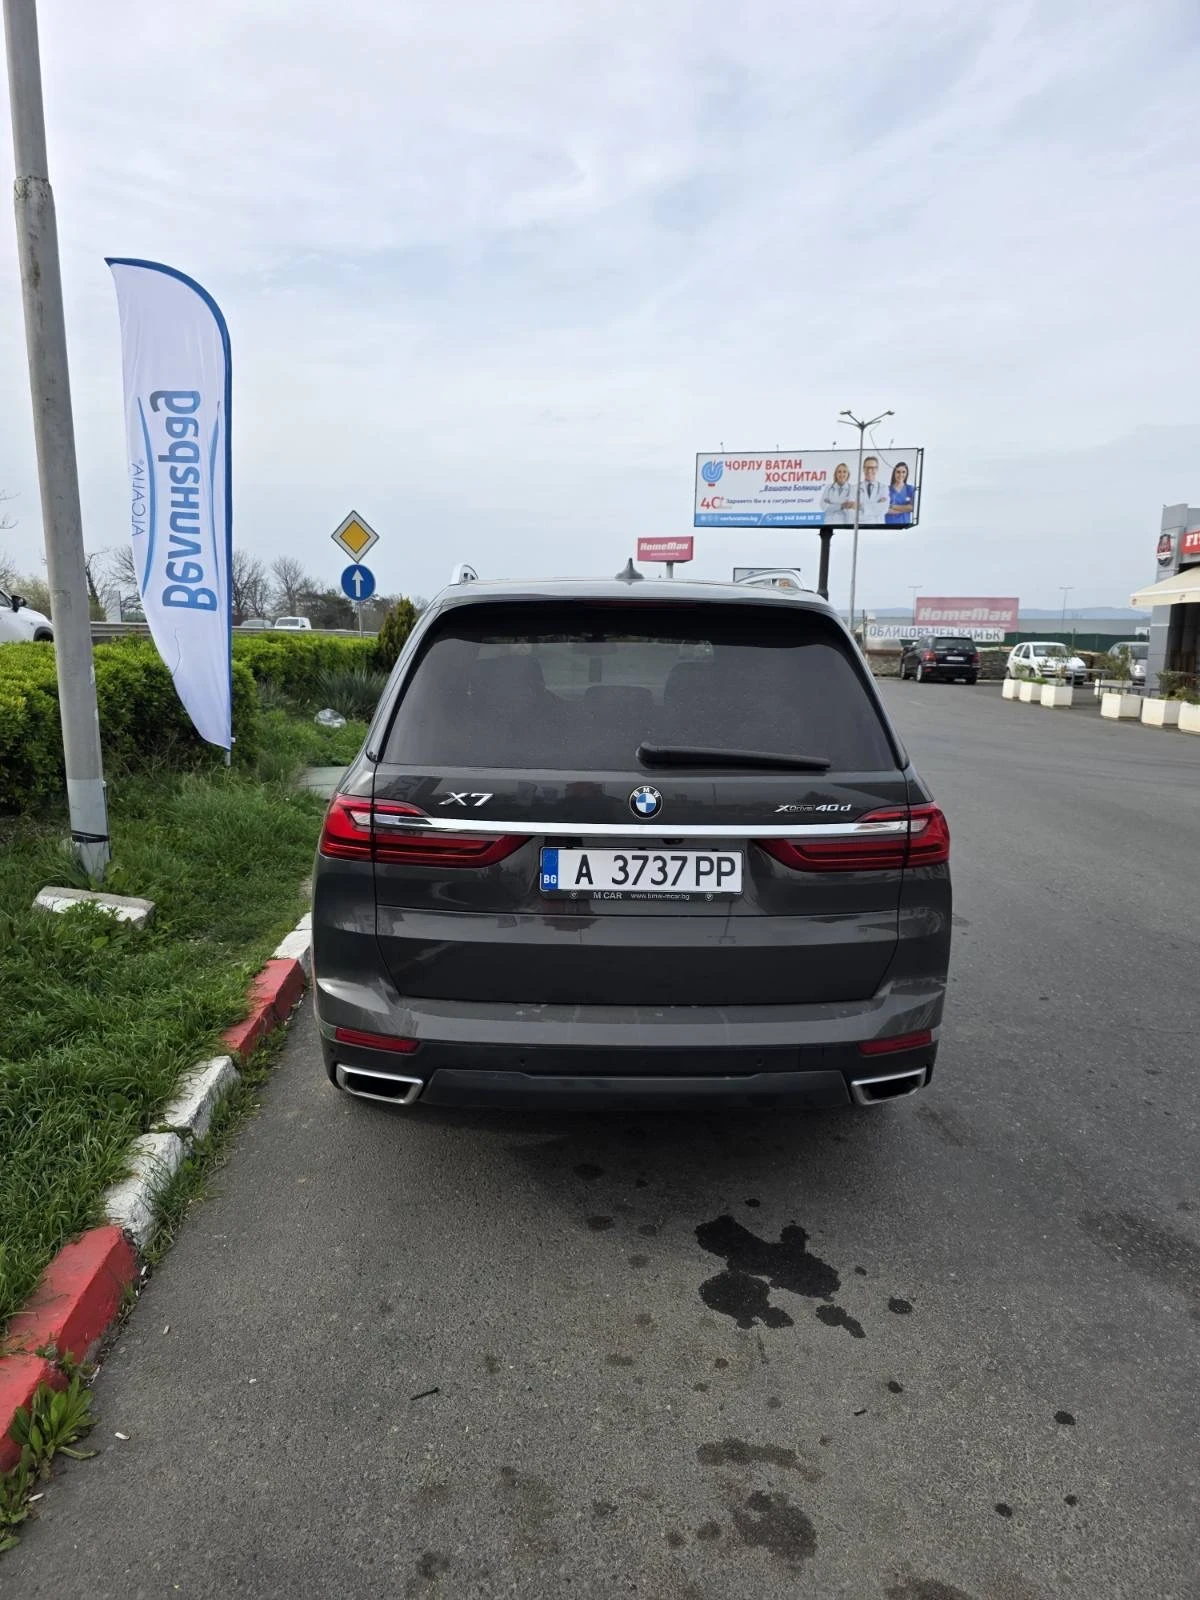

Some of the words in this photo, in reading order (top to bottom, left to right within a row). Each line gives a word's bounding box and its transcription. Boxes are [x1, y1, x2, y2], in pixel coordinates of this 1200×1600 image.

[724, 460, 763, 471] ЧОРЛУ
[765, 459, 802, 470] ВАТАН
[765, 470, 827, 483] ХОСПИТАЛ
[1186, 533, 1200, 546] FI
[439, 791, 494, 806] X7
[633, 787, 660, 798] BMW
[574, 854, 594, 885] A
[611, 854, 688, 886] 3737
[695, 855, 736, 887] PP
[543, 875, 557, 884] BG
[593, 891, 601, 900] M
[603, 891, 623, 900] CAR
